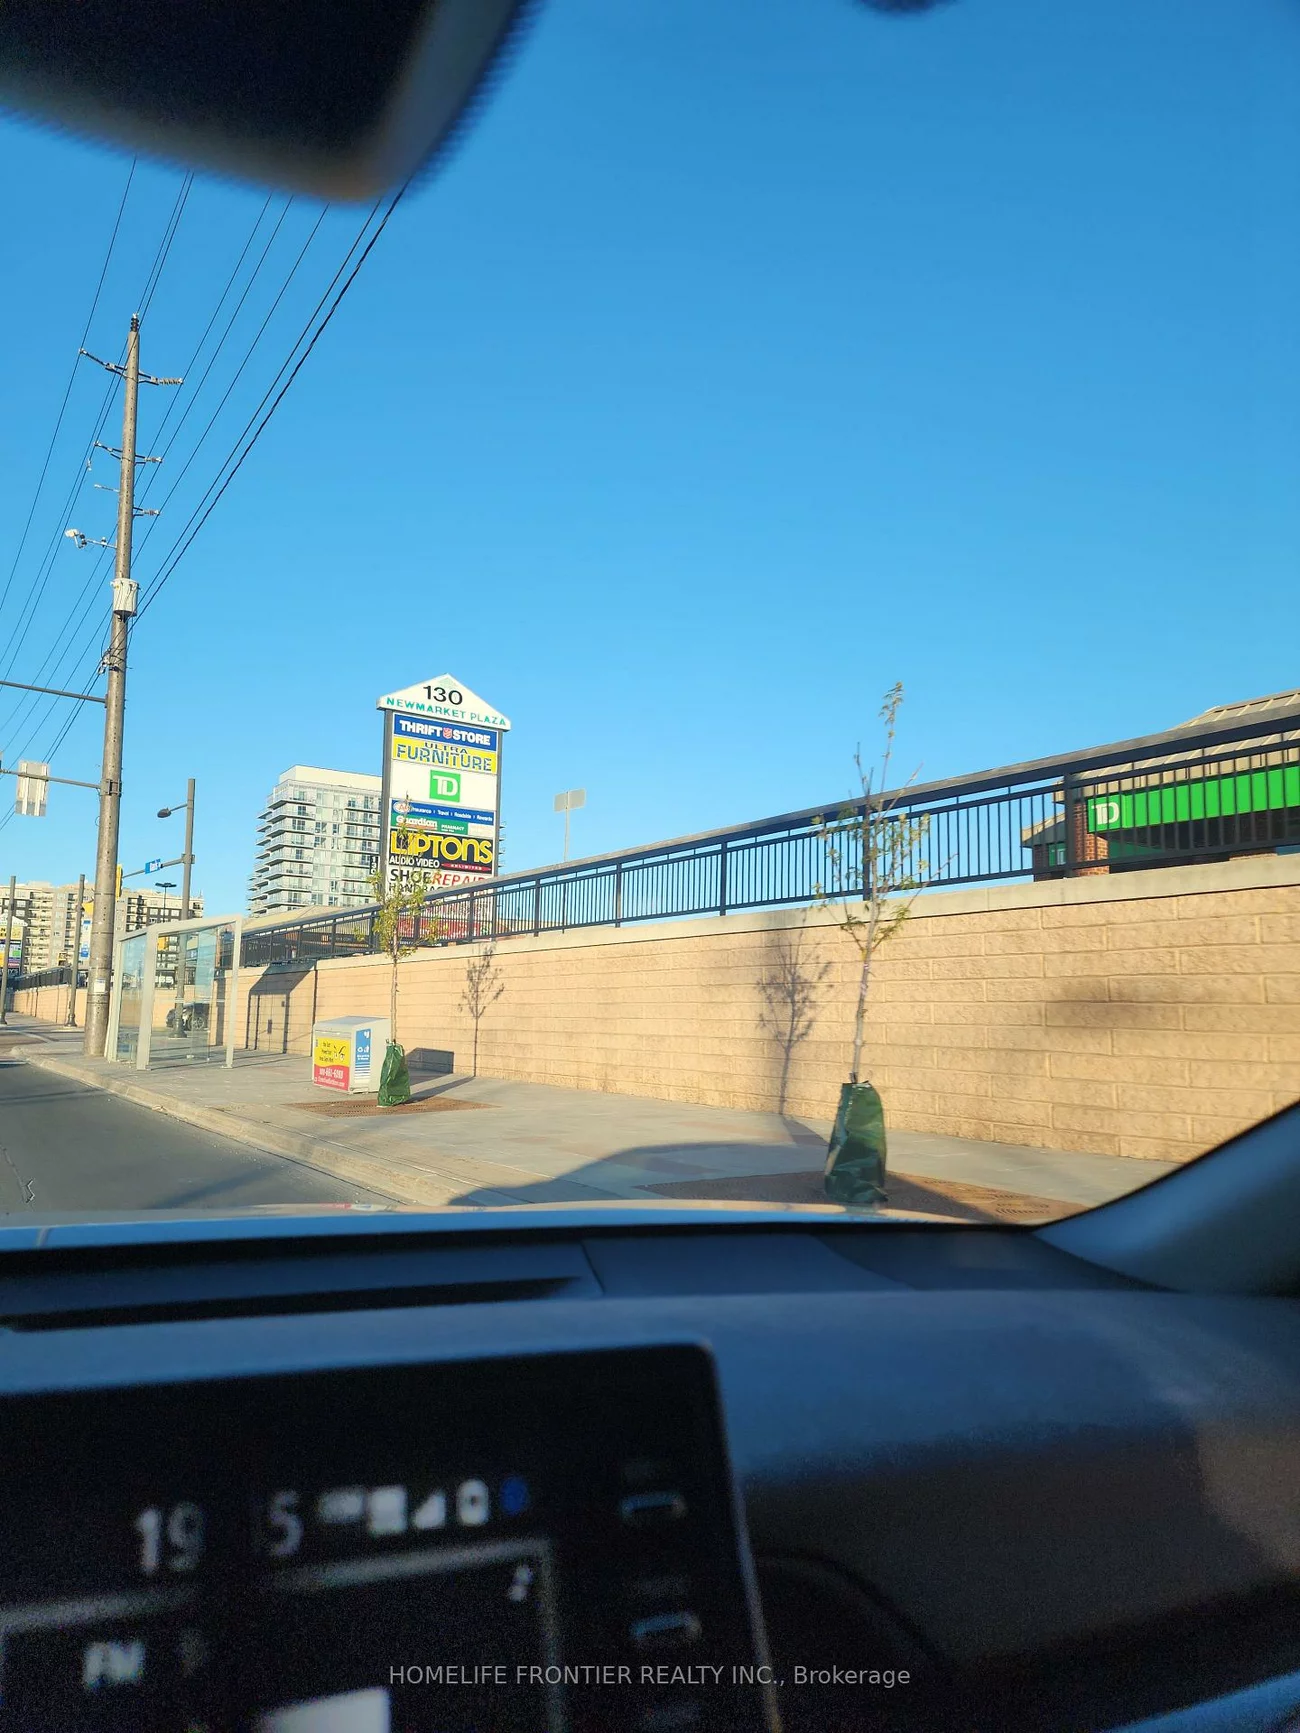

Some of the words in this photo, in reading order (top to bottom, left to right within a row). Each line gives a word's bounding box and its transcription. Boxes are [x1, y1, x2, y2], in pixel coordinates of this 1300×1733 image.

[423, 685, 463, 706] 130
[386, 697, 466, 719] NEWMARKET
[470, 712, 507, 726] PLAZA
[399, 720, 442, 737] THRIFT
[452, 731, 491, 746] STORE
[396, 743, 492, 771] FURNITURE
[424, 742, 468, 754] ULTRA
[432, 775, 459, 796] TD
[1091, 801, 1120, 825] TD
[389, 855, 415, 866] AUDIO
[415, 858, 440, 869] VIDEO
